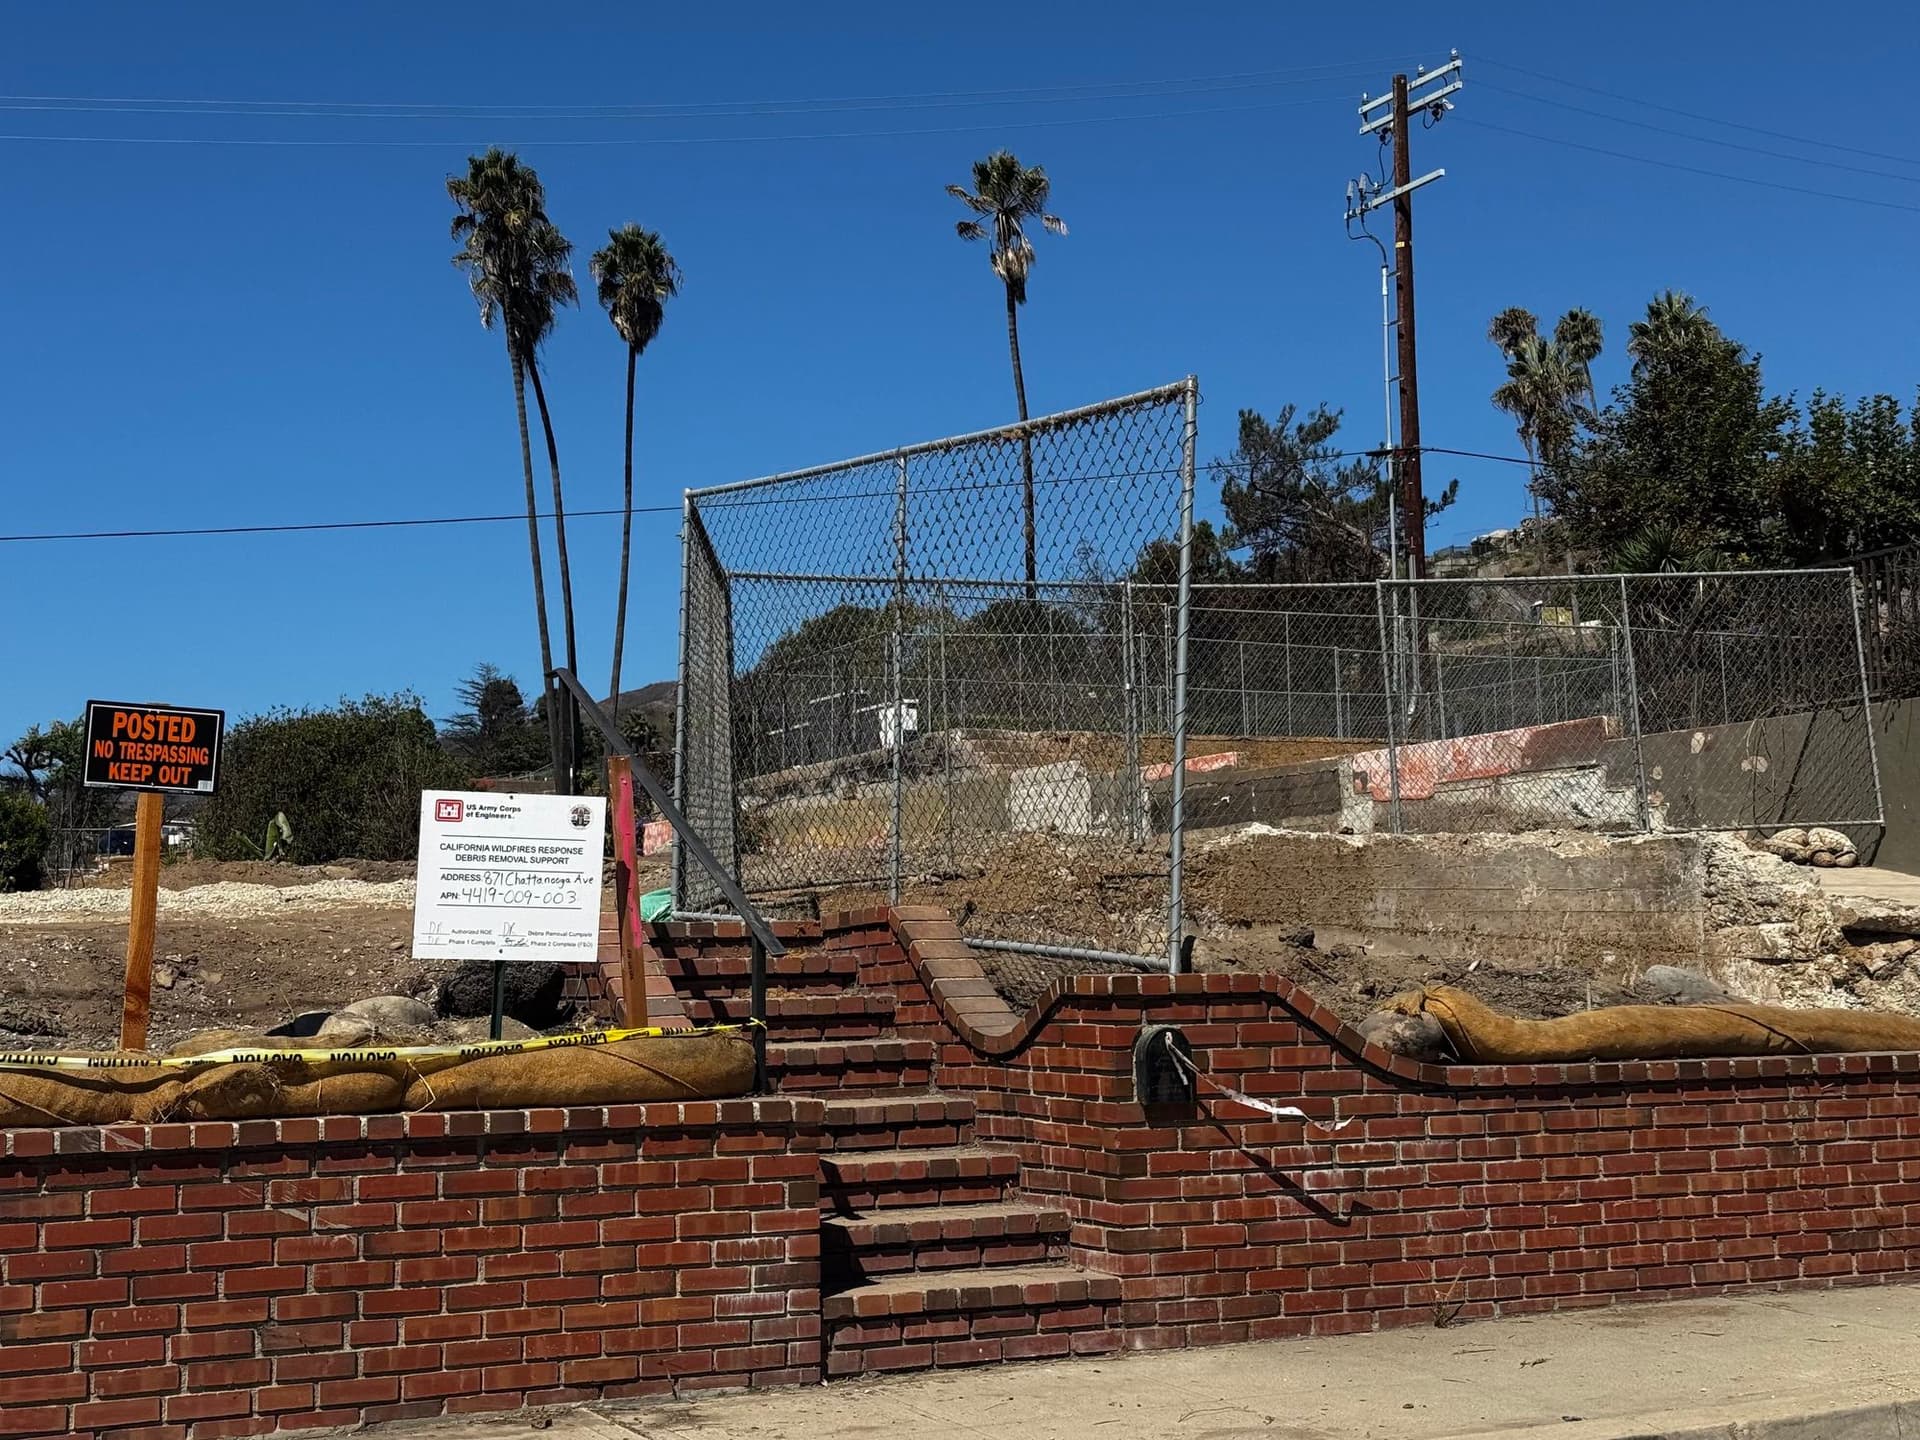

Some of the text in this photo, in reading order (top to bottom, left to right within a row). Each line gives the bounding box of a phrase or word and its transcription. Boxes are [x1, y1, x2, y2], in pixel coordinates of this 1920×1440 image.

[112, 711, 196, 743] POSTED
[94, 739, 209, 765] NO TRESPASSING
[108, 762, 192, 785] KEEP OUT
[479, 805, 498, 813] Army
[500, 805, 522, 814] Corps
[439, 843, 584, 855] CALIFORNIA WILDFIRES RESPONSE
[455, 854, 570, 865] DEBRIS REMOVAL SUPPORT
[483, 871, 504, 887] 871
[574, 874, 594, 885] Ave
